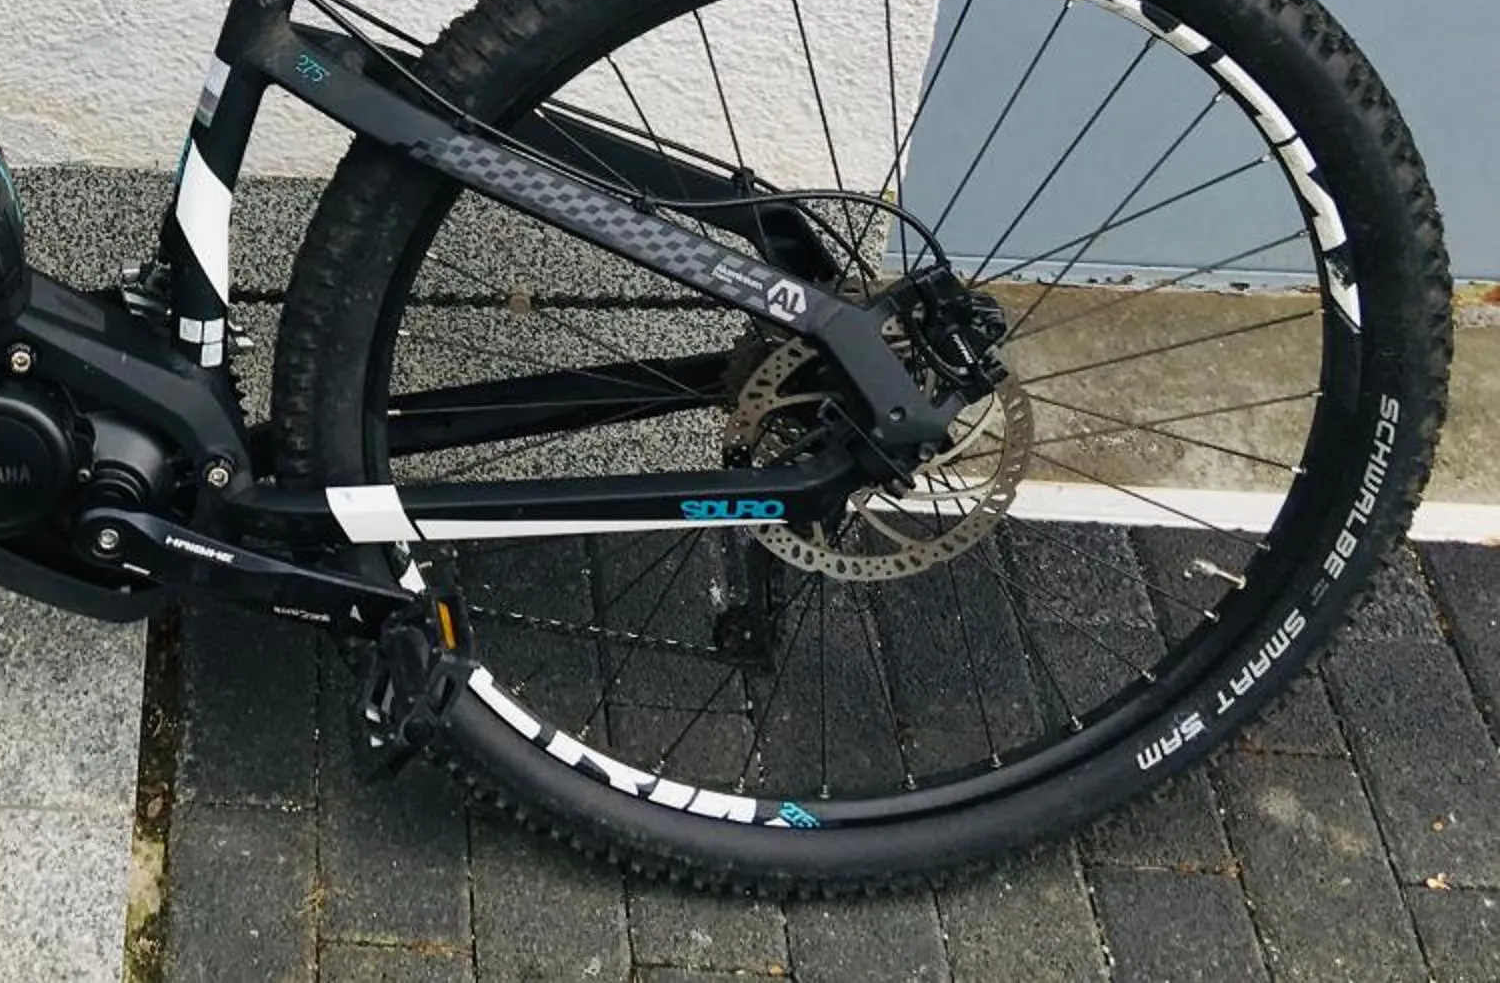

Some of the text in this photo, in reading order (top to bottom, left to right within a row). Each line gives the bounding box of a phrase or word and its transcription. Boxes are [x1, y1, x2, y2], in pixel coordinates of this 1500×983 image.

[680, 500, 786, 521] SDURO
[1136, 393, 1400, 771] SCHWALBE SMART SAM
